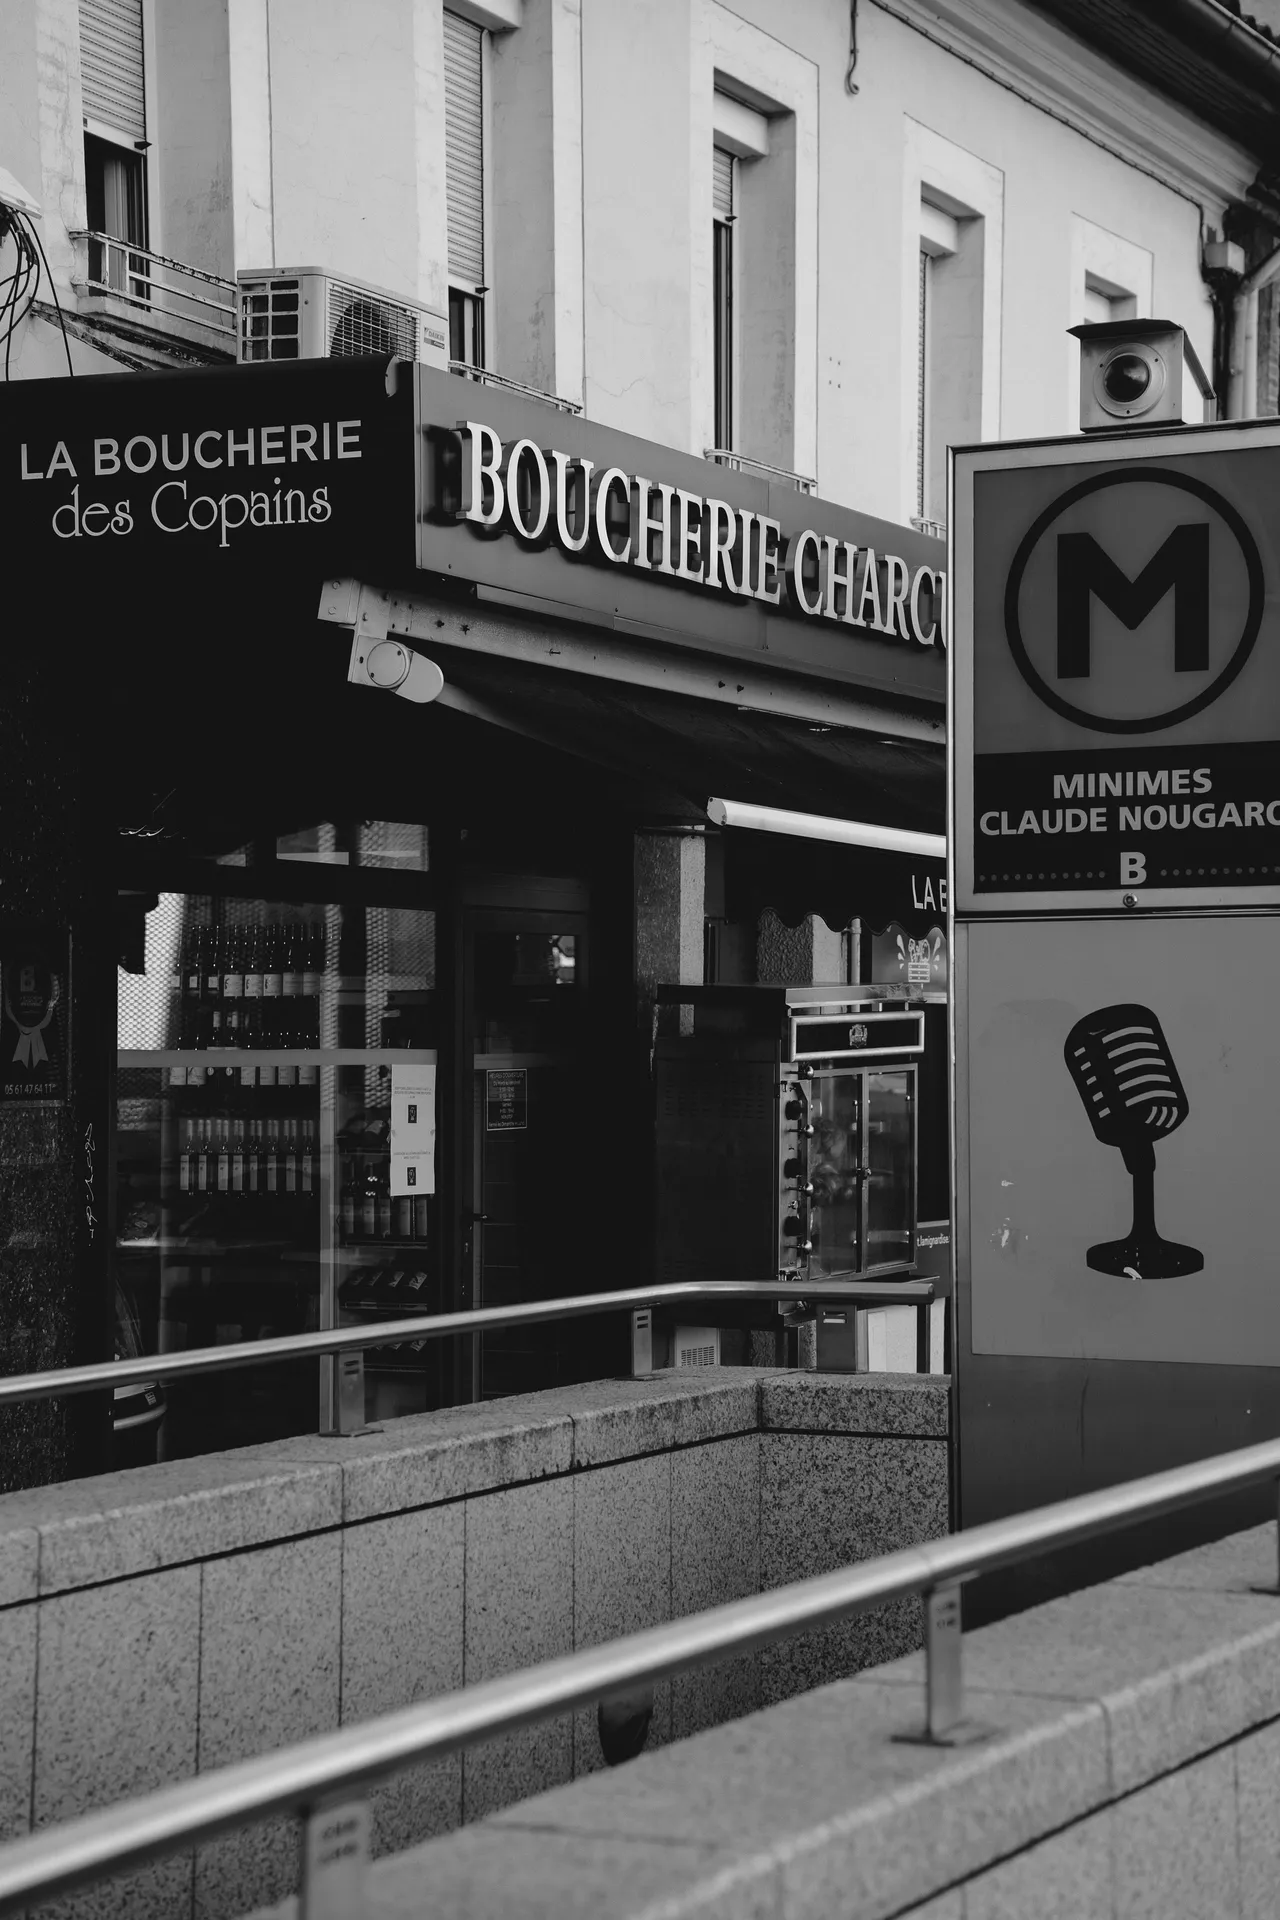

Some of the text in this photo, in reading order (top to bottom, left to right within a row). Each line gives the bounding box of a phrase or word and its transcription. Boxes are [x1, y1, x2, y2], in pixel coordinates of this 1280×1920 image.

[20, 419, 362, 480] LA BOUCHERIE
[51, 476, 333, 548] des Copains
[463, 420, 782, 604] BOUCHERIE
[1057, 523, 1210, 680] M
[1053, 767, 1213, 799] MINIMES
[979, 806, 1108, 836] CLAUDE
[1119, 851, 1148, 886] B
[911, 874, 937, 911] LA
[4, 1084, 14, 1095] 05
[14, 1084, 23, 1095] 61
[24, 1084, 34, 1094] 47
[34, 1083, 44, 1094] 64
